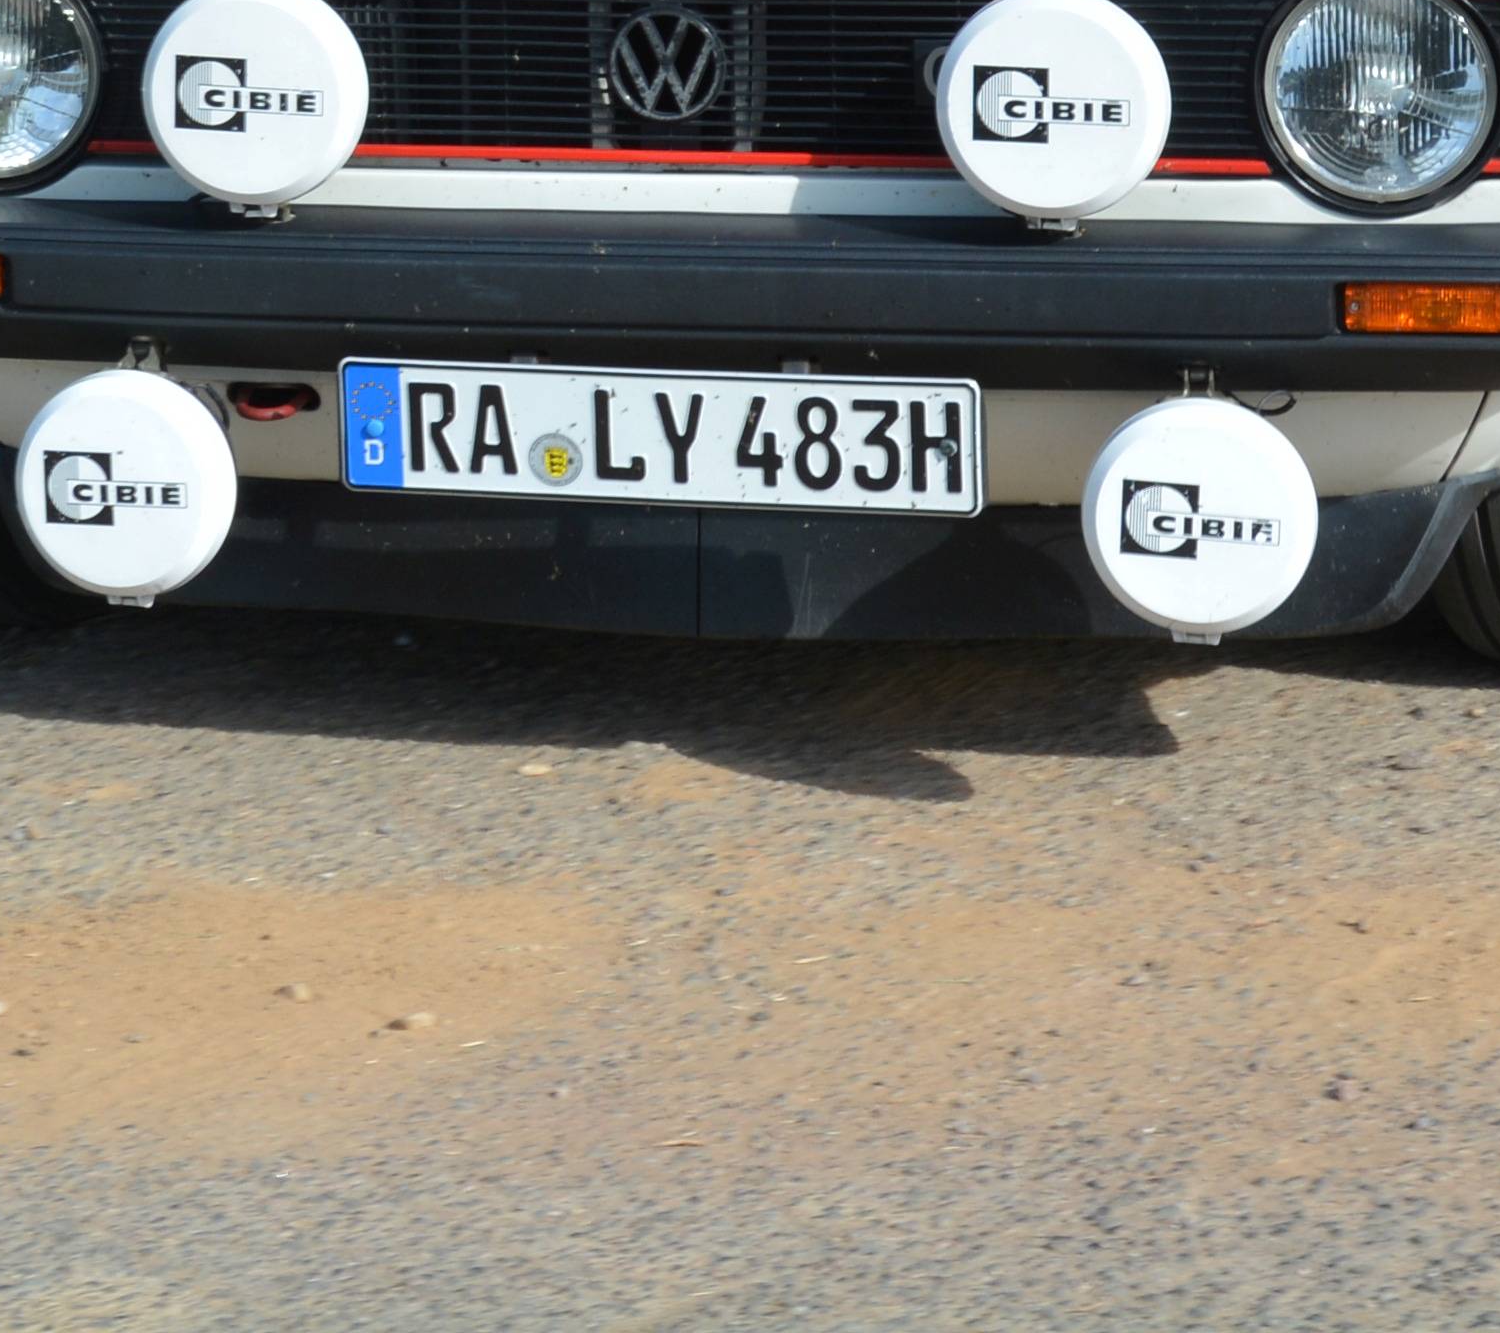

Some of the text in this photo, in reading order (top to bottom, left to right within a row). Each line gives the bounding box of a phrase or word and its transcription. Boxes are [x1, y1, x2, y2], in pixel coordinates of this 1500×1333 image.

[363, 438, 385, 466] D
[408, 381, 963, 495] RA LY 483H
